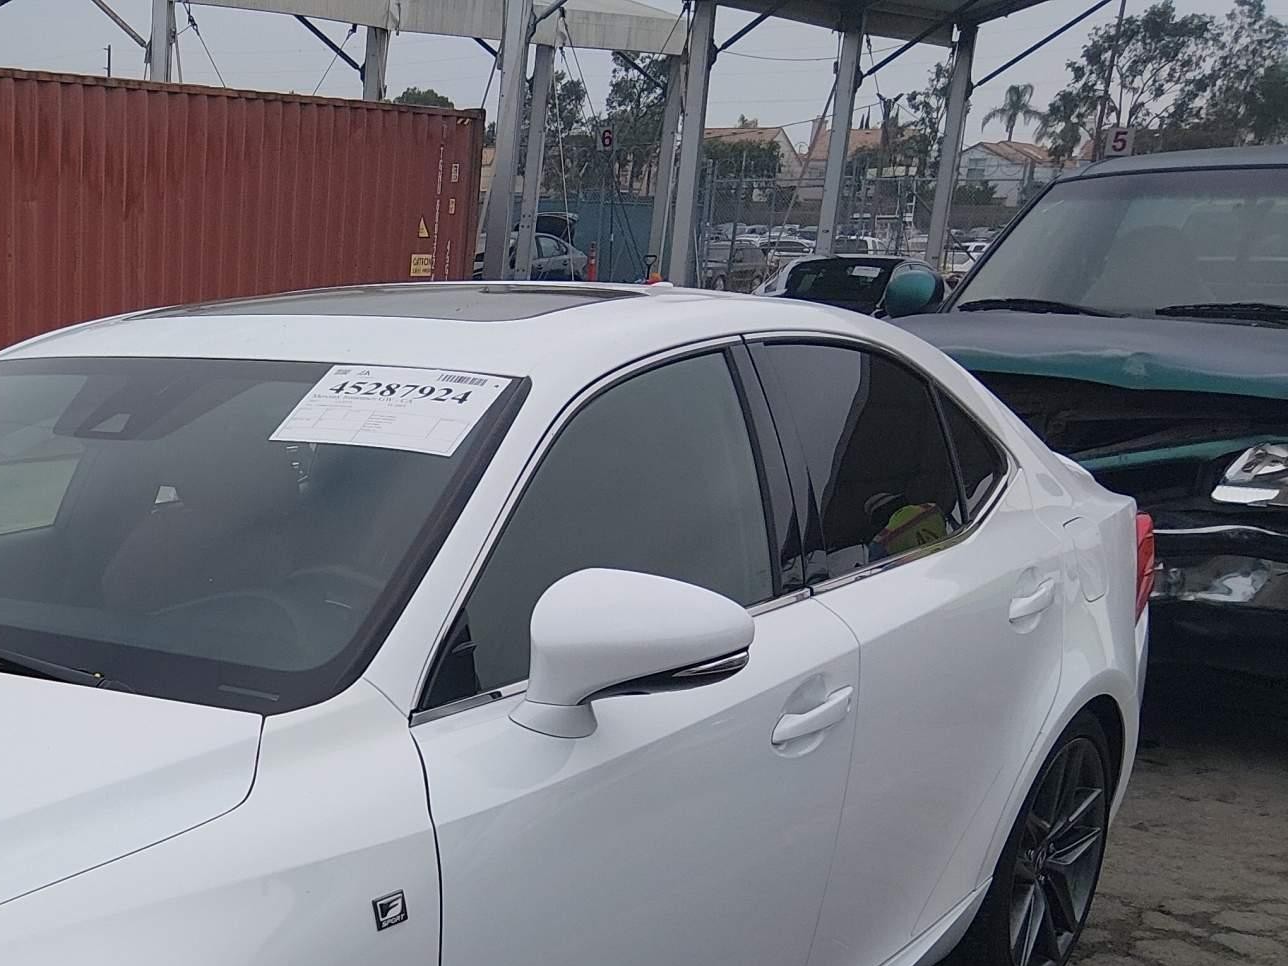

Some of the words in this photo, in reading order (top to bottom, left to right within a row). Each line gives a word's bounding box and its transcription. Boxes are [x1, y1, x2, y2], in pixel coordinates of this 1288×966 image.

[601, 129, 612, 147] 6
[1112, 131, 1128, 152] 5
[329, 381, 473, 404] 45287924
[381, 913, 406, 928] SPORT
